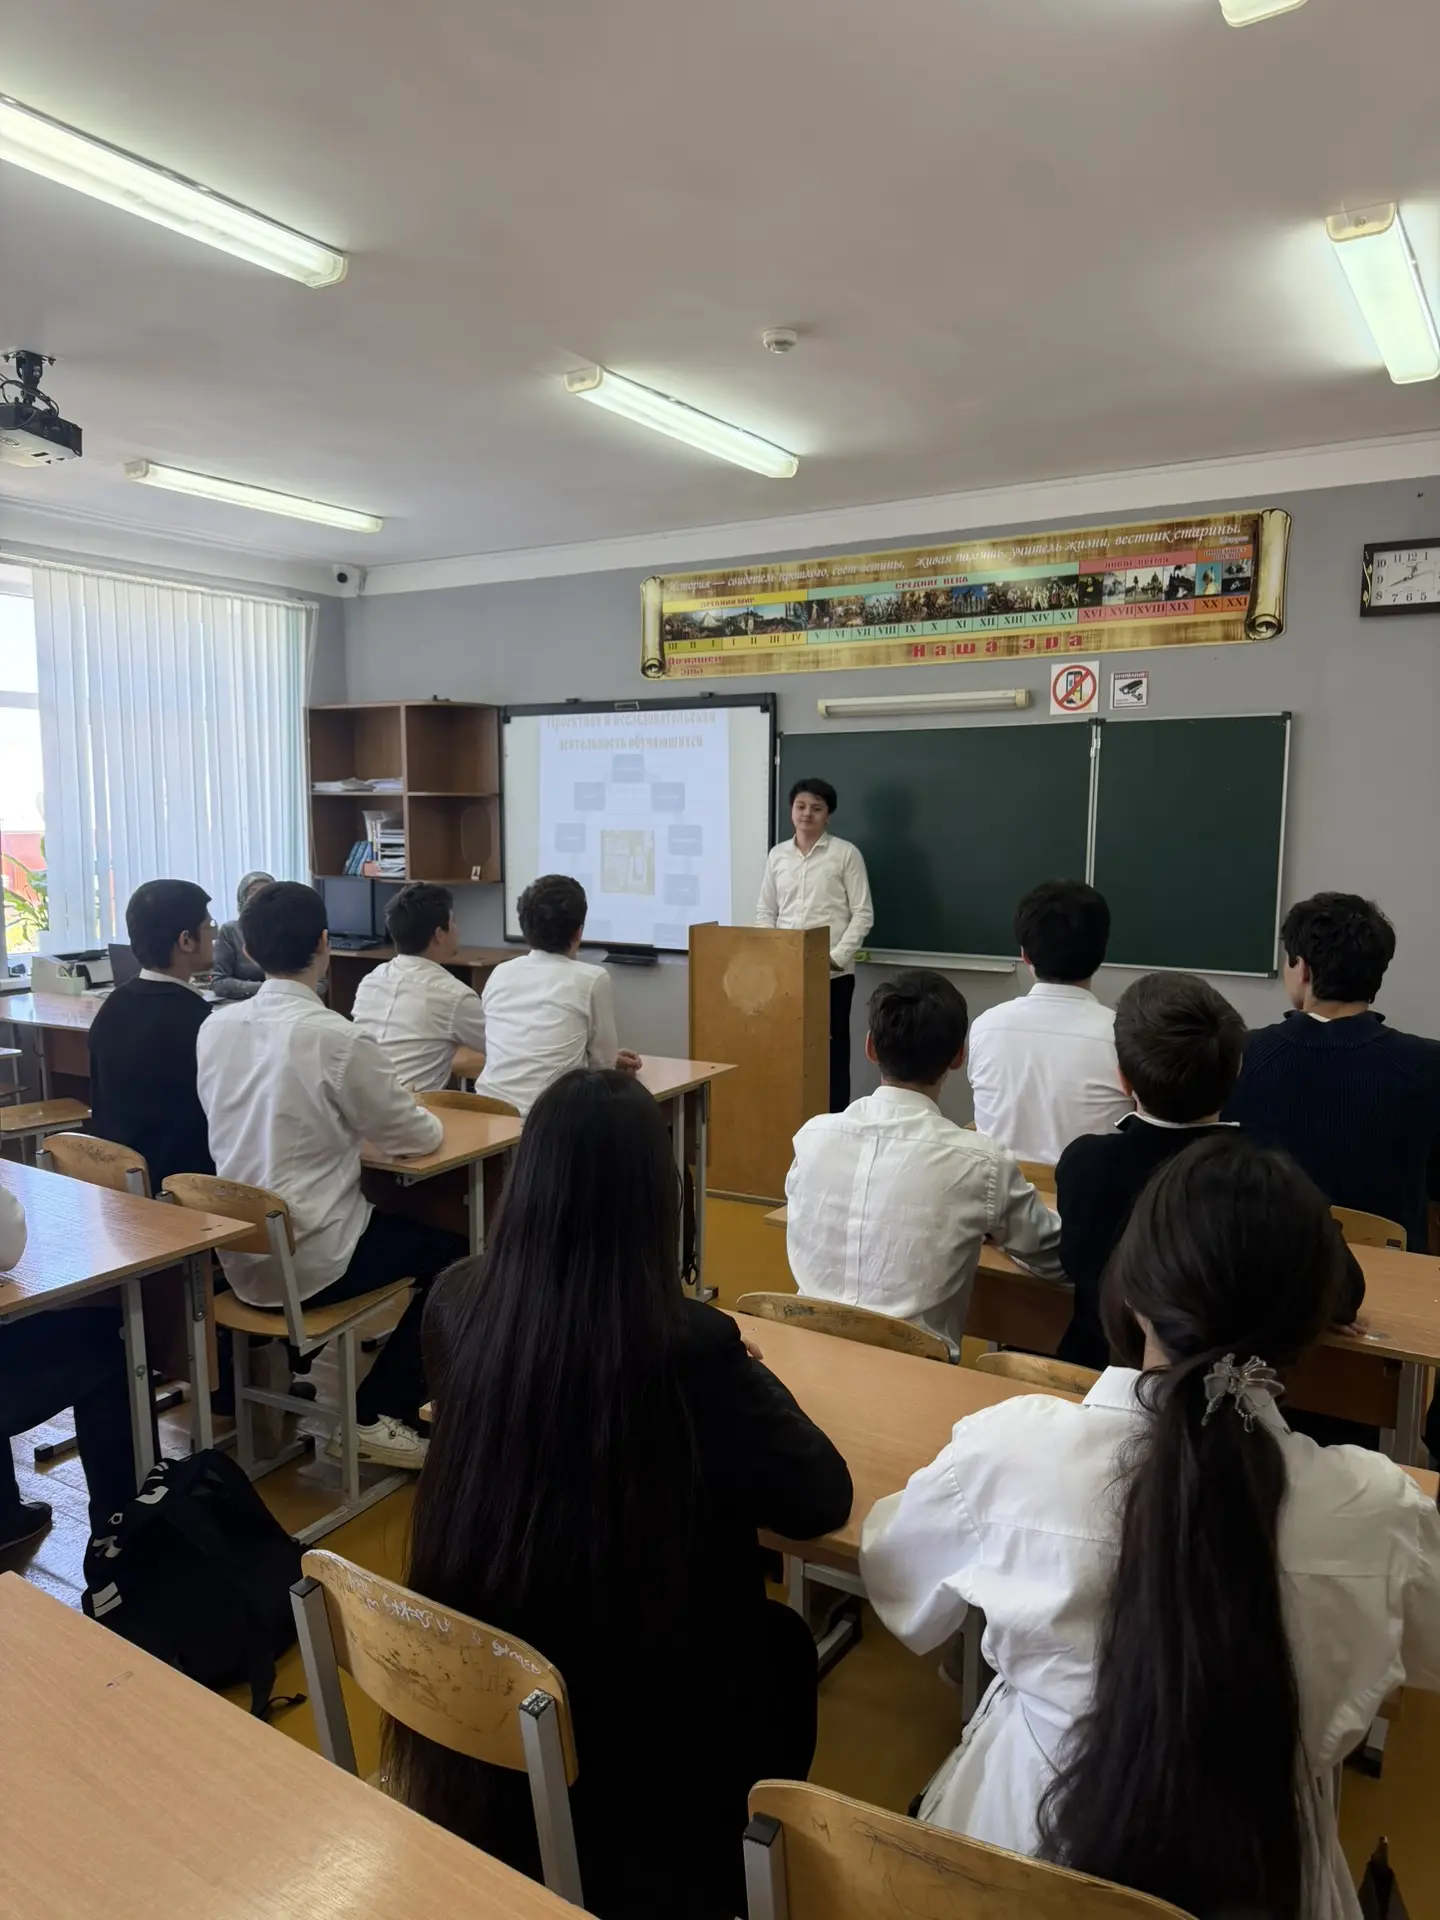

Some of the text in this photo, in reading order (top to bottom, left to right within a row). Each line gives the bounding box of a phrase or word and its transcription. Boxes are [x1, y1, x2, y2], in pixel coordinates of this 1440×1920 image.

[727, 572, 777, 587] свидетель
[1011, 542, 1062, 558] учитель
[1065, 538, 1110, 553] жизни,
[1115, 530, 1174, 546] вестник
[1173, 524, 1241, 542] старины.
[1376, 559, 1386, 568] 10
[1393, 554, 1402, 562] 11
[1407, 552, 1418, 561] 12
[1391, 593, 1399, 602] 7
[1406, 593, 1413, 601] 6
